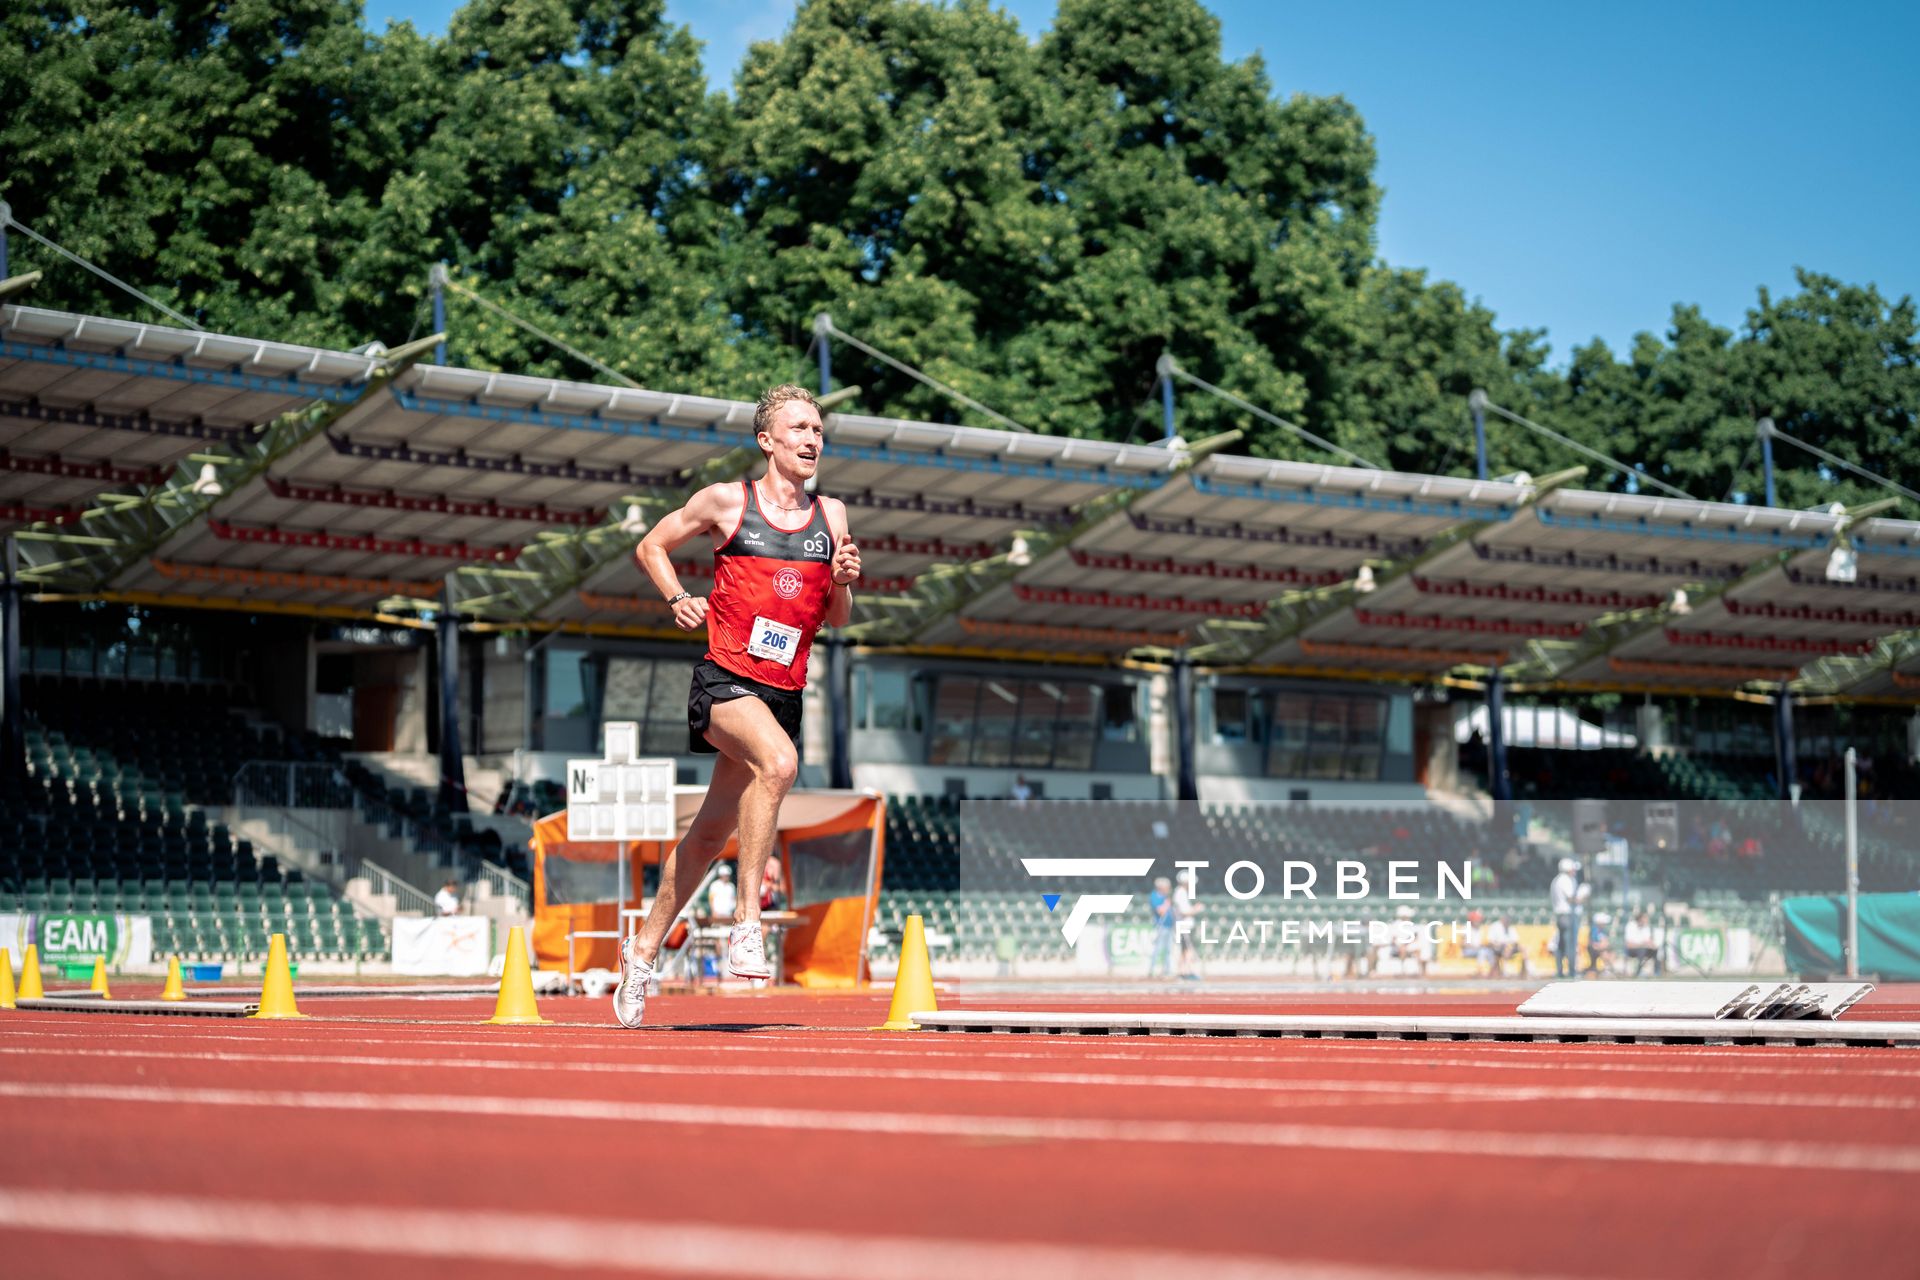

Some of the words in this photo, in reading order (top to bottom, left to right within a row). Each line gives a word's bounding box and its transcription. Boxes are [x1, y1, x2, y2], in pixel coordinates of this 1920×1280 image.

[804, 539, 824, 553] OS
[762, 630, 788, 650] 206
[44, 919, 108, 952] EAM
